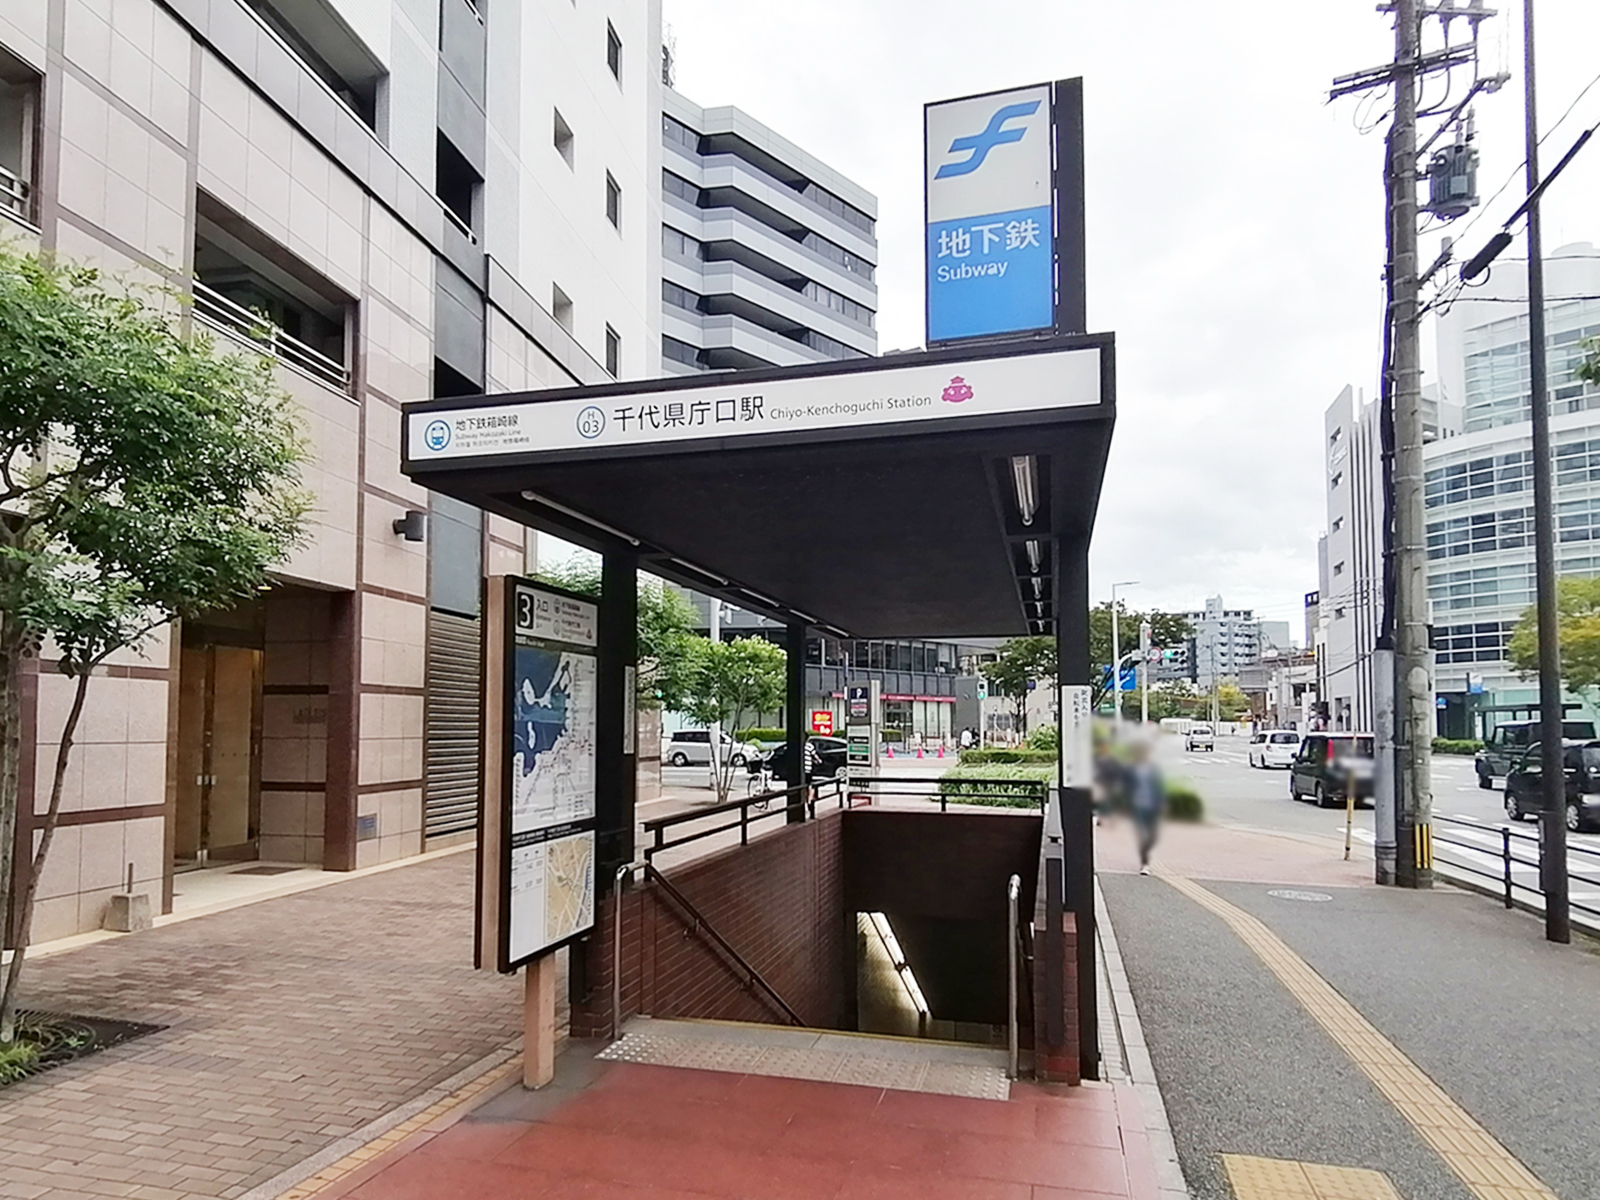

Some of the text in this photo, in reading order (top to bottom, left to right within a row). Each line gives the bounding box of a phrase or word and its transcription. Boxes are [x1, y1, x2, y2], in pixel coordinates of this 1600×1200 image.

[937, 218, 1040, 258] 地下鉄
[937, 261, 1008, 282] Subway
[587, 411, 595, 419] H
[613, 395, 765, 433] 千代県庁口駅
[770, 395, 932, 421] Chiyo-Kenchoguchi Station
[455, 414, 519, 431] 地下鉄箱崎線
[582, 420, 600, 434] 03
[479, 430, 506, 438] Hakozaki
[519, 594, 531, 627] 3
